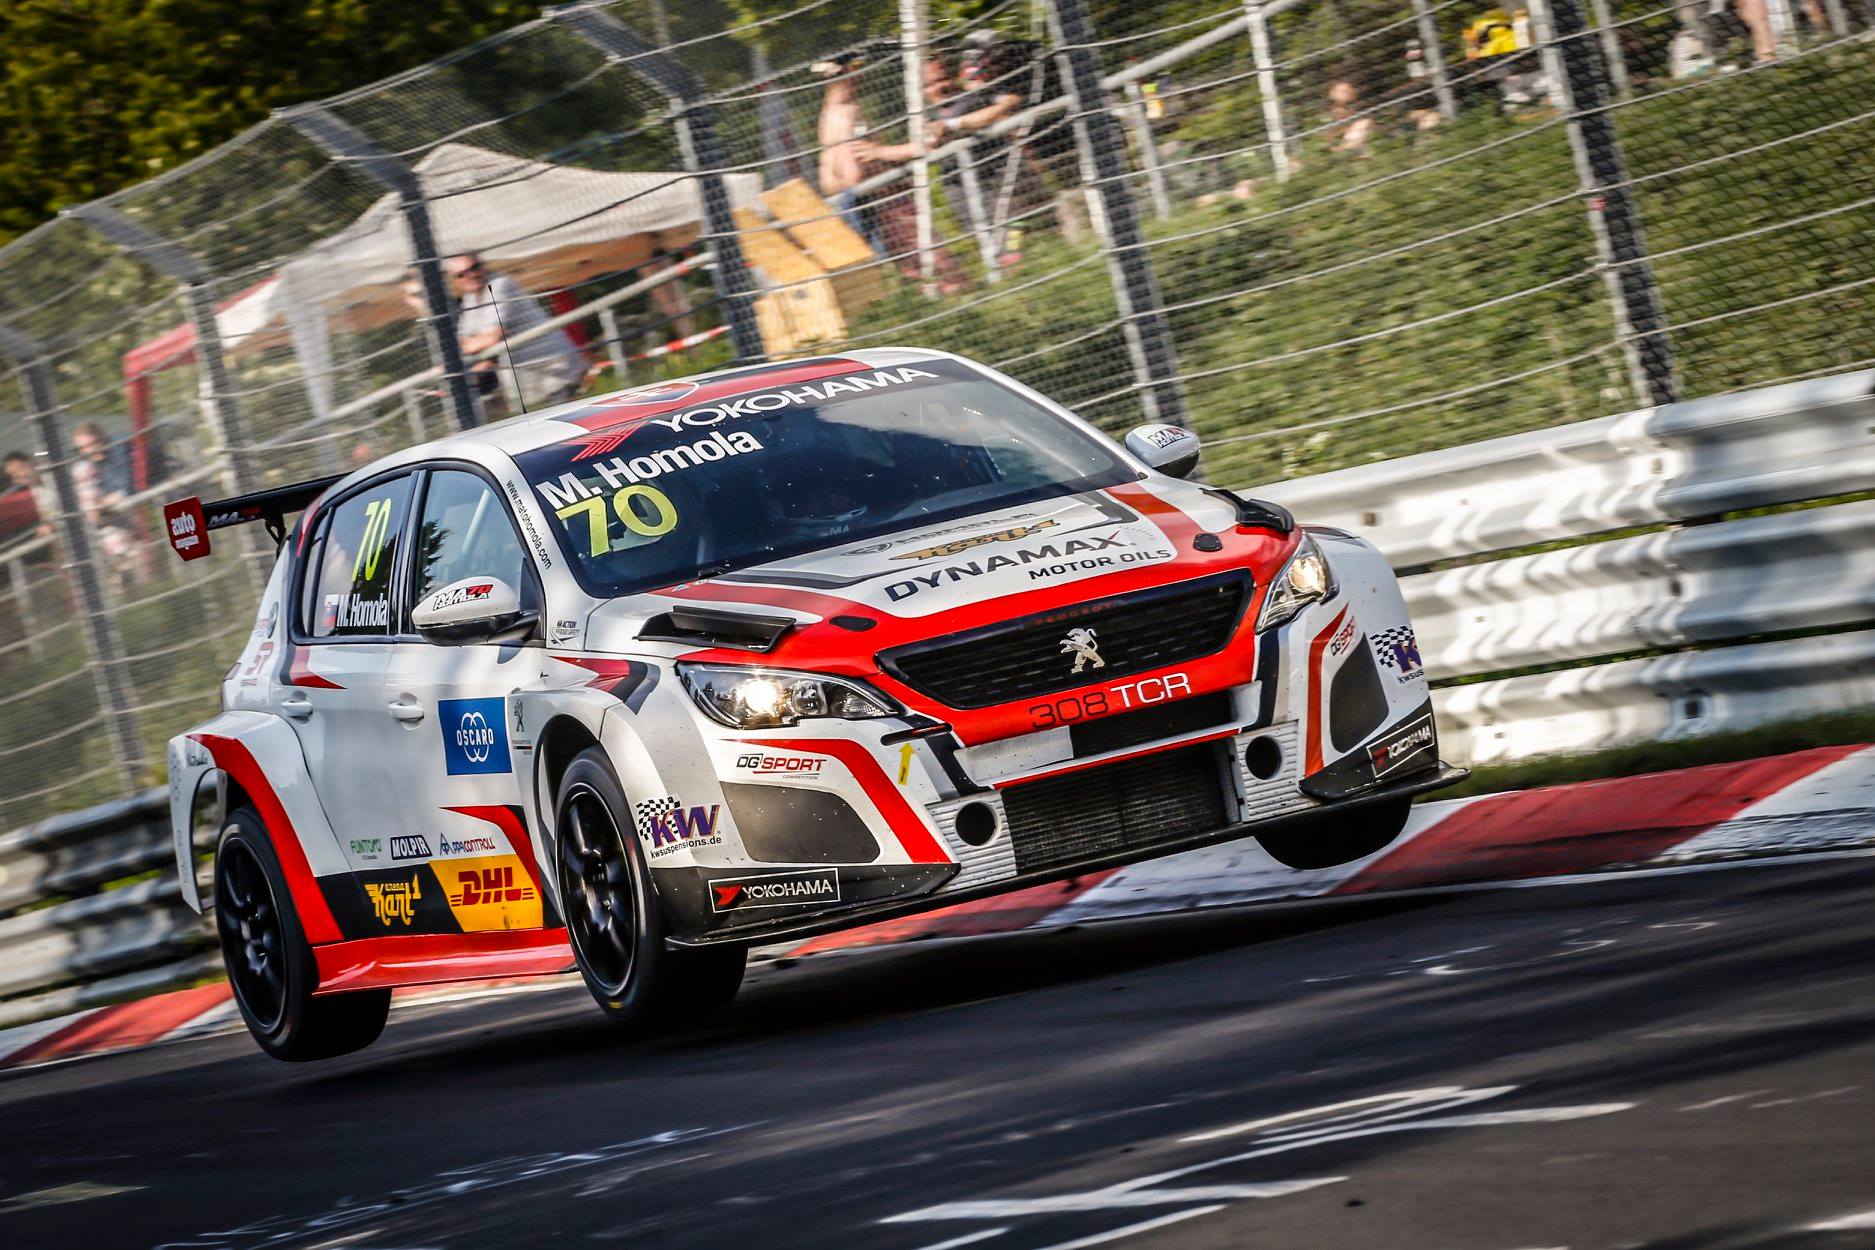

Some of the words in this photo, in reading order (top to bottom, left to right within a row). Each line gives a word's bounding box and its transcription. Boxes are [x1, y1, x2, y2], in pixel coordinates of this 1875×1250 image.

[652, 367, 939, 433] YOKOHAMA
[351, 498, 392, 581] 70
[506, 479, 552, 570] www.matohomola.com
[555, 484, 679, 558] 70
[884, 529, 1127, 602] DYNAMAX
[1029, 557, 1114, 580] MOTOR
[1120, 548, 1172, 564] OILS
[1029, 691, 1110, 731] 308
[1110, 672, 1191, 709] TCR
[456, 727, 494, 747] OSCARO
[391, 837, 430, 858] MOLPIR
[649, 804, 721, 848] KW
[650, 835, 722, 860] kwsuspensions.de
[457, 867, 522, 906] DHL
[742, 878, 834, 900] YOKOHAMA
